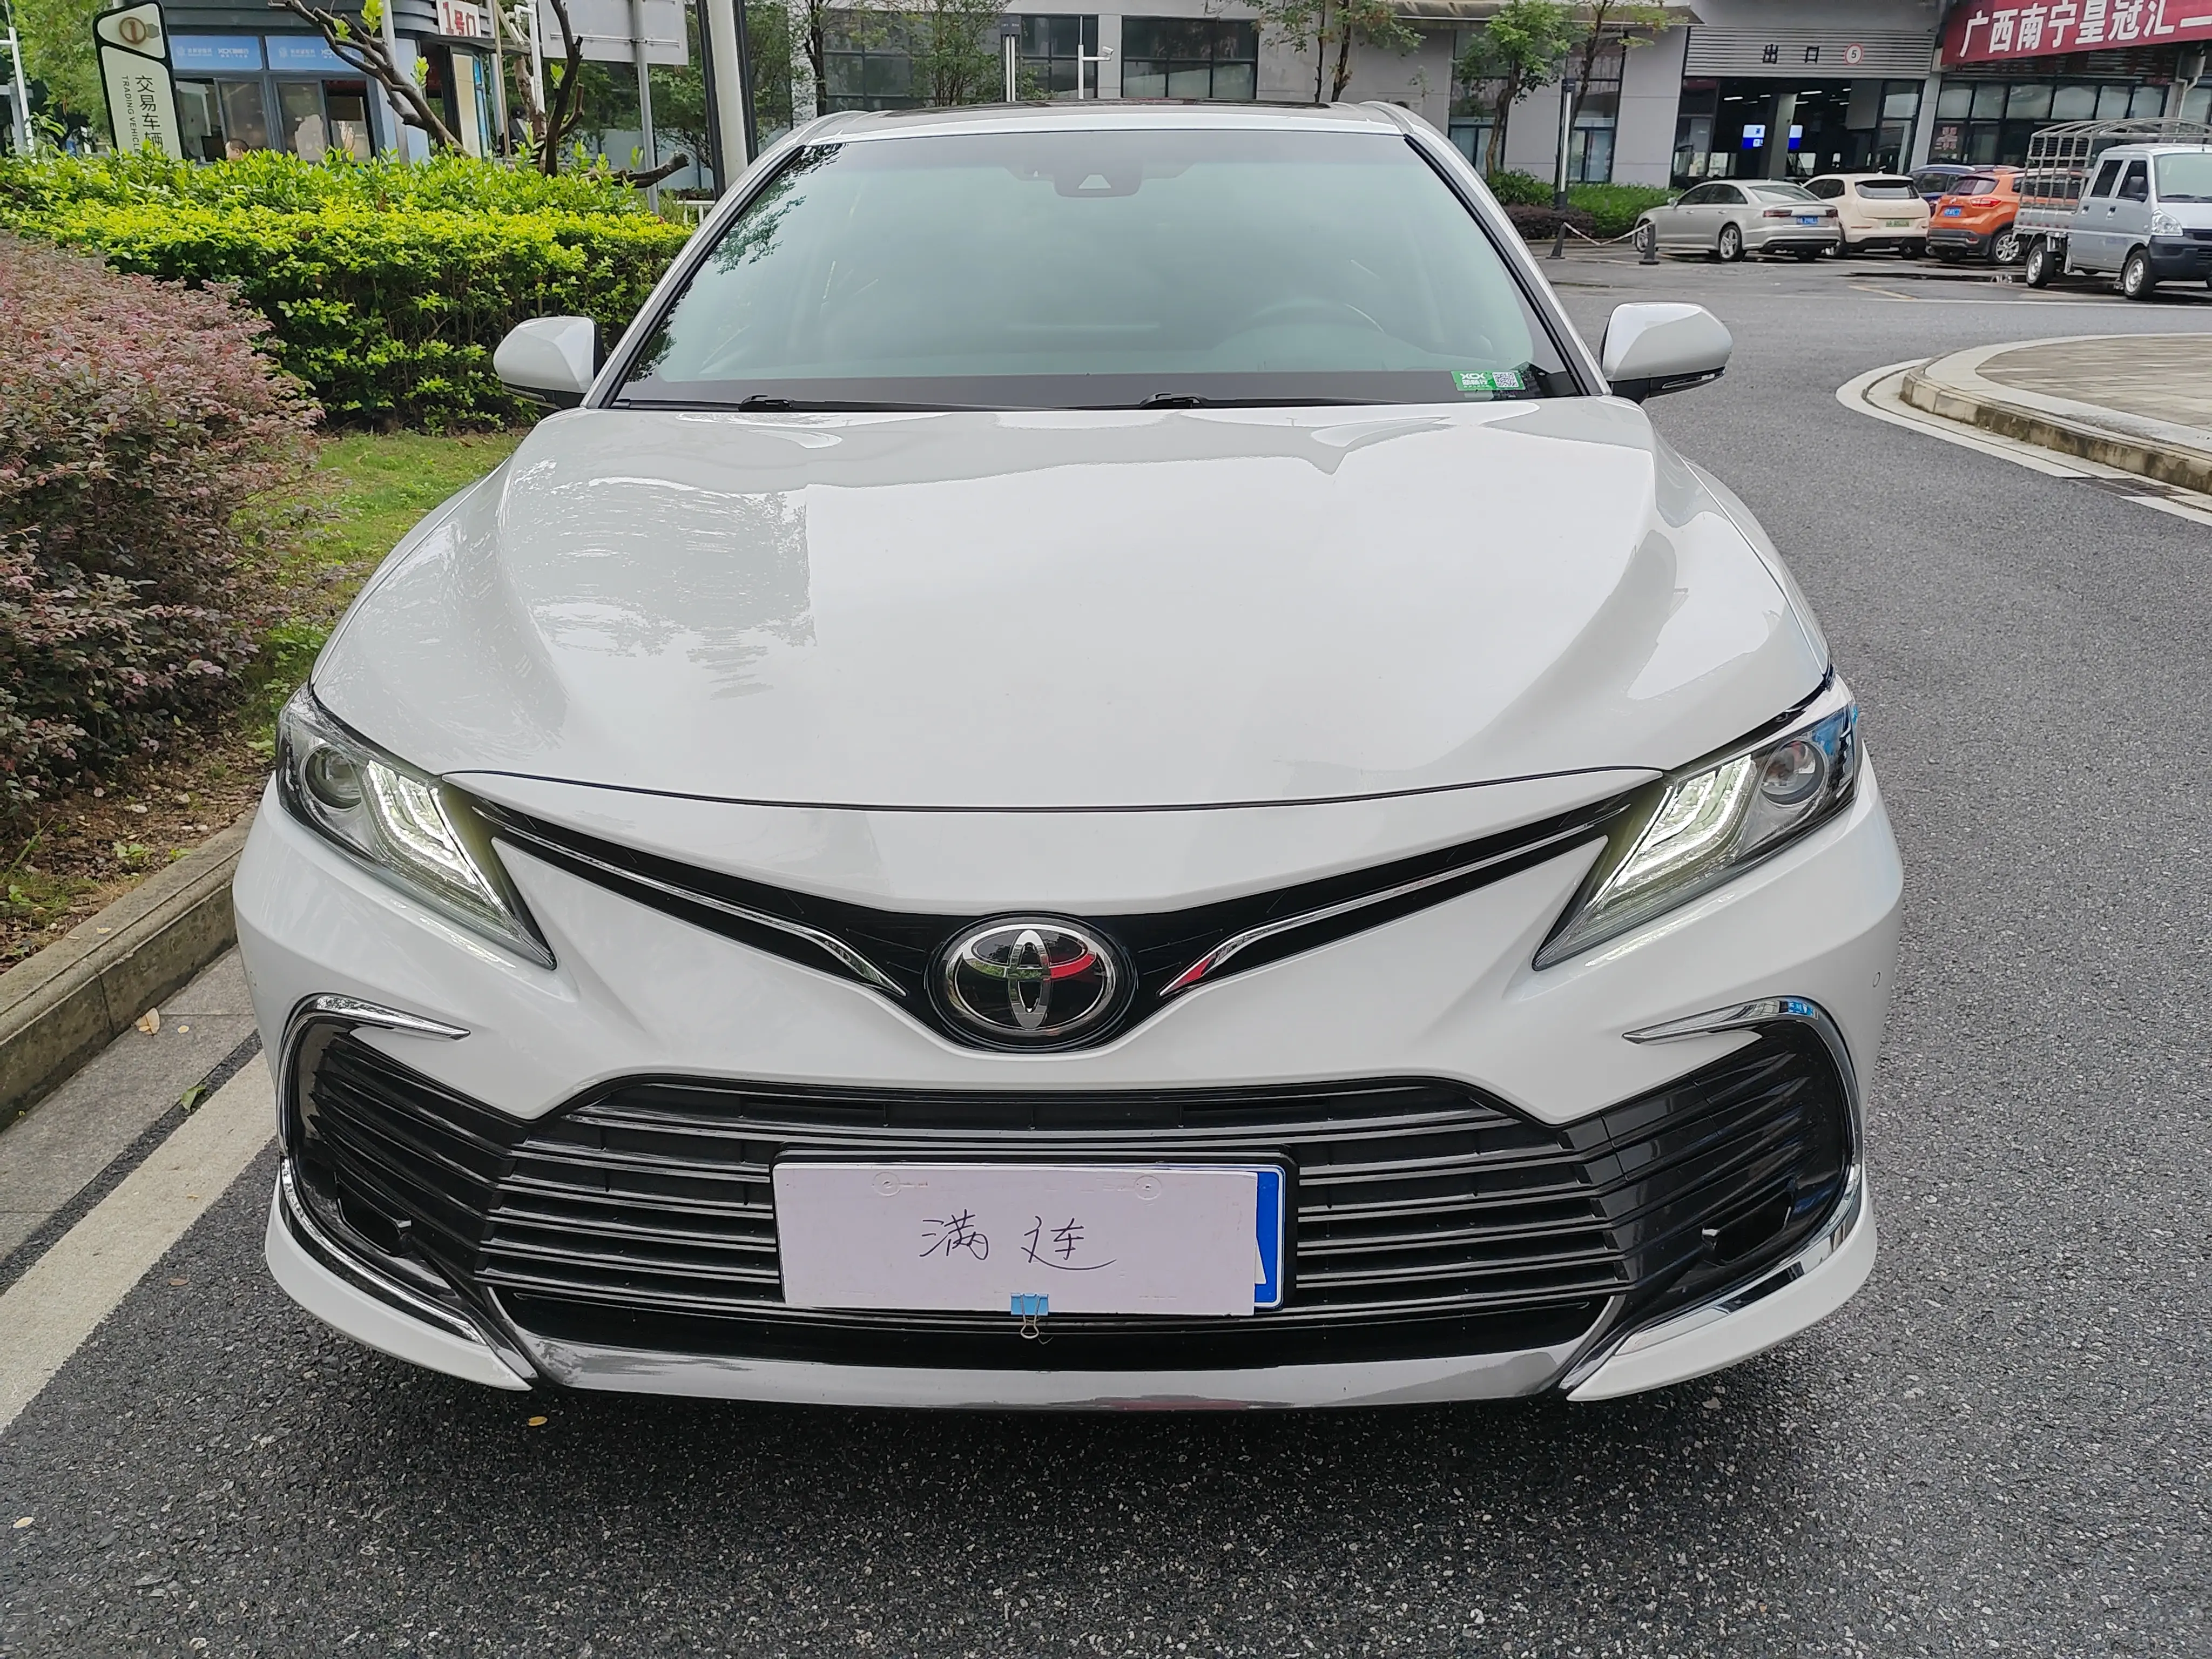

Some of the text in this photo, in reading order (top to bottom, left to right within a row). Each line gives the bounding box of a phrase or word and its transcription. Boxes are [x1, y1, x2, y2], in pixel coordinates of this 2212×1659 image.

[1762, 44, 1858, 64] 出口 5
[122, 75, 134, 114] TRADING
